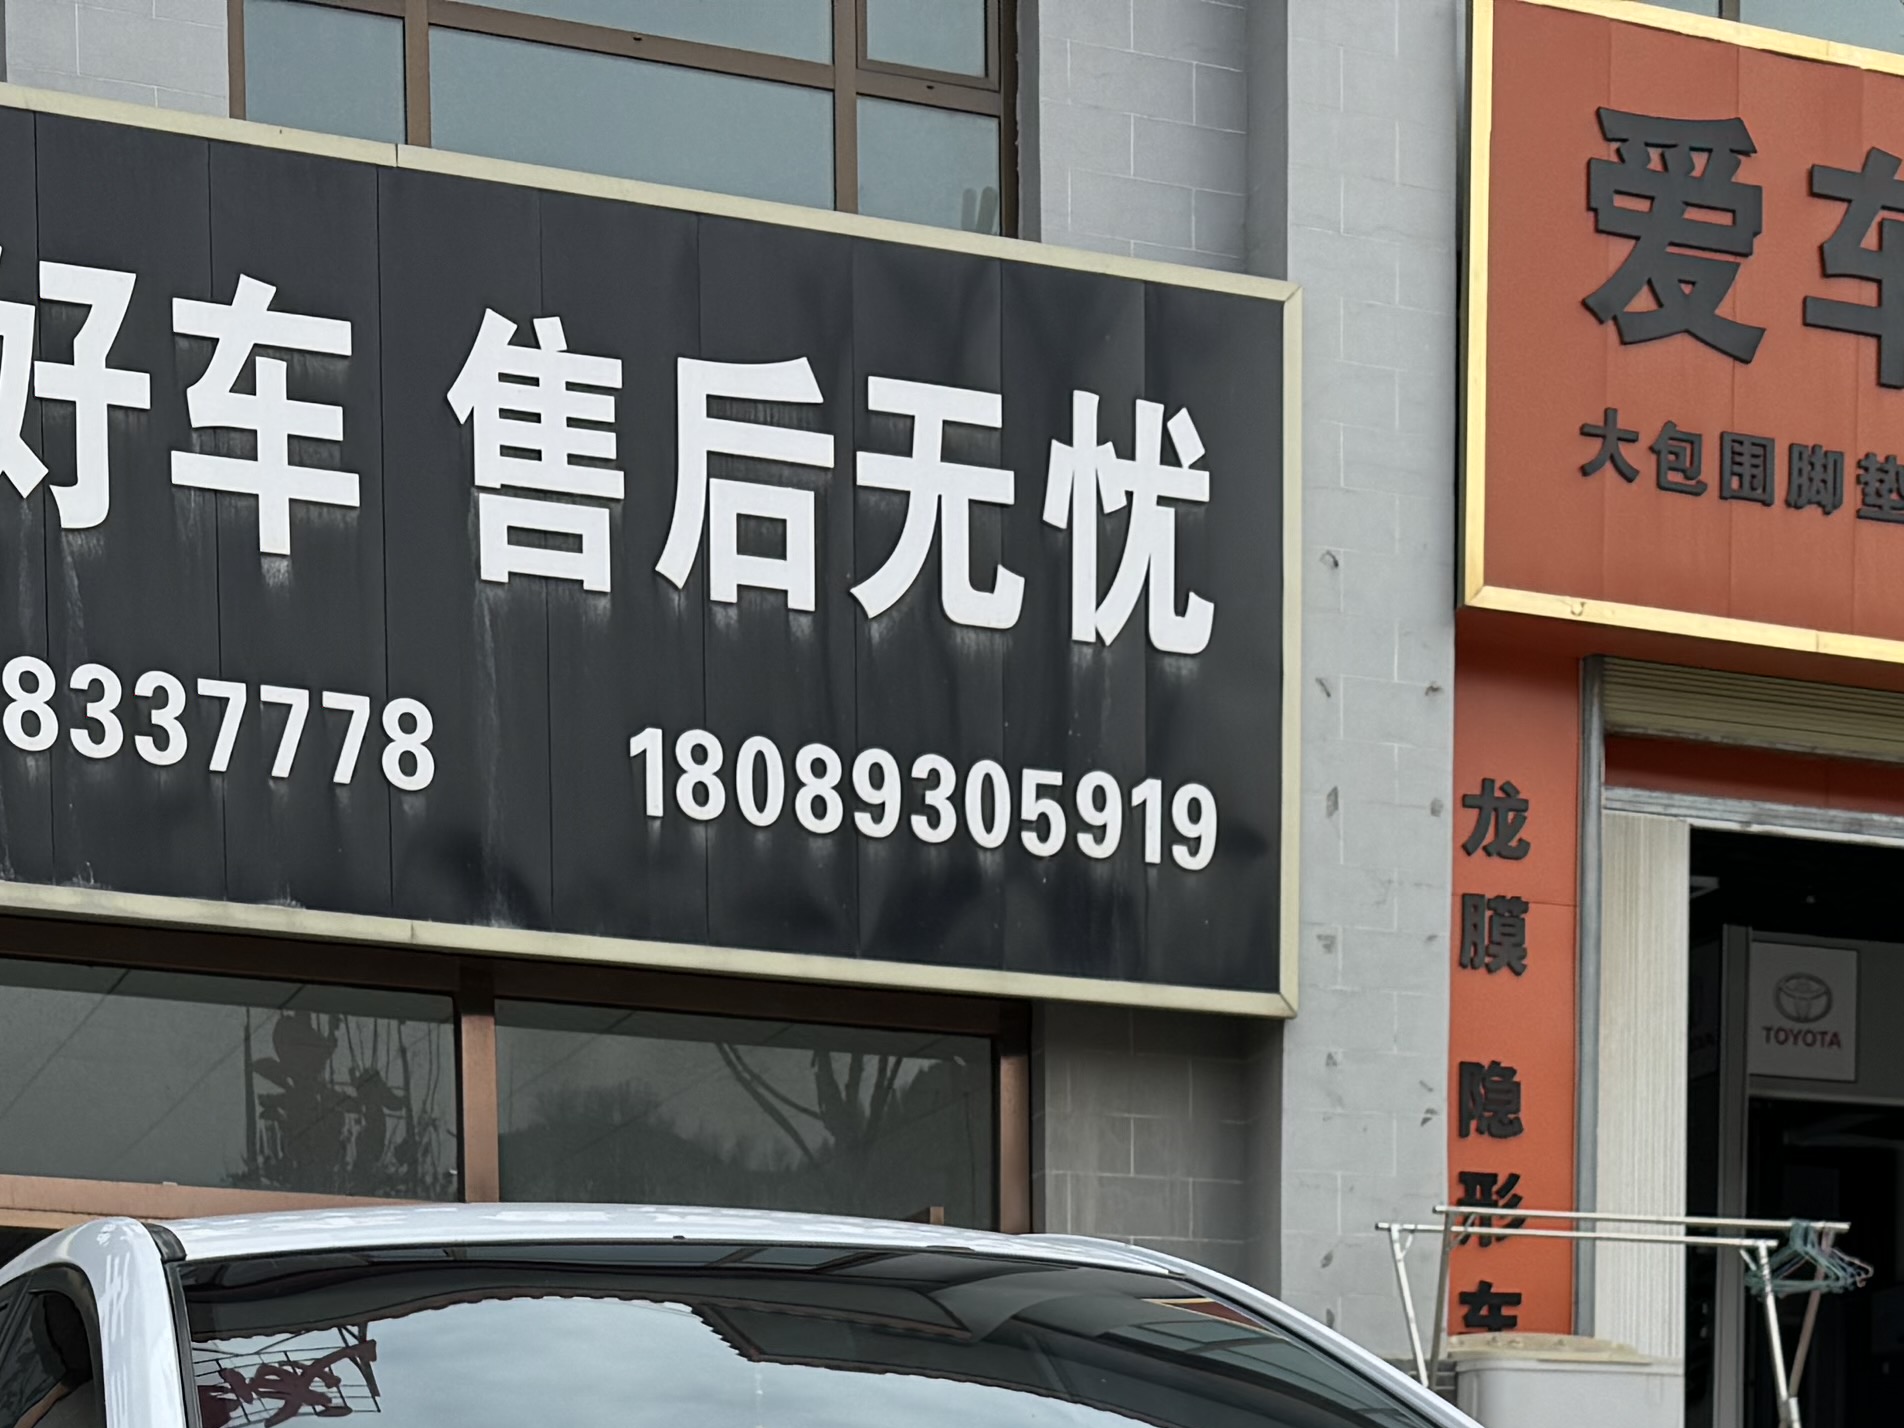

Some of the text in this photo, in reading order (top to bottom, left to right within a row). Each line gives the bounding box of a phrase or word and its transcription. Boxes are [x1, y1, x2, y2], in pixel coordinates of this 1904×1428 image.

[447, 307, 1215, 655] 售后无忧
[629, 726, 1218, 870] 18089305919
[1761, 1025, 1842, 1051] TOYOTA
